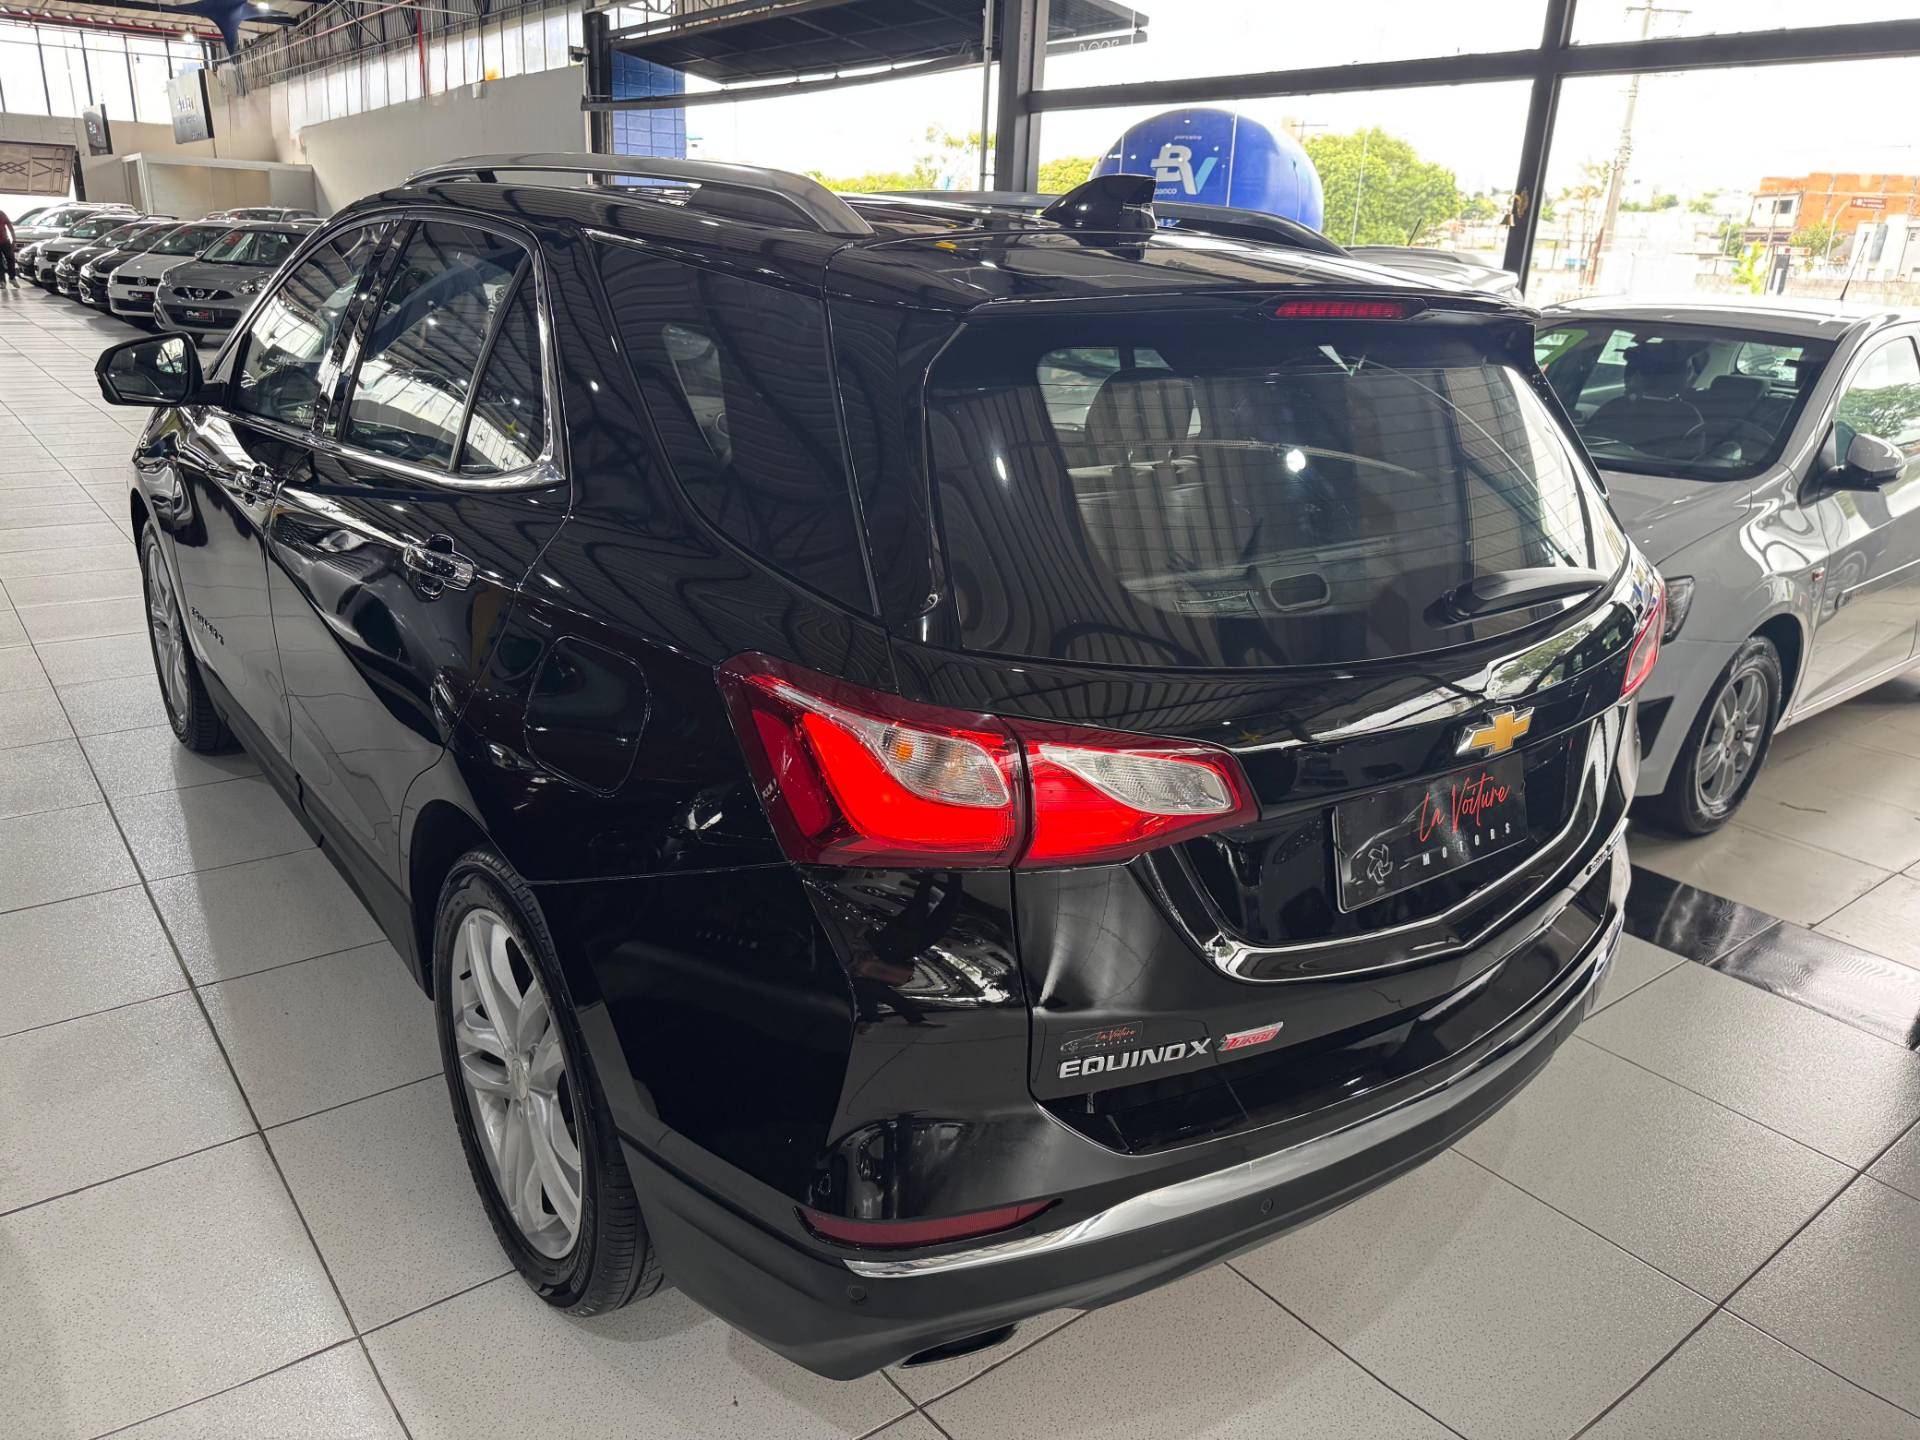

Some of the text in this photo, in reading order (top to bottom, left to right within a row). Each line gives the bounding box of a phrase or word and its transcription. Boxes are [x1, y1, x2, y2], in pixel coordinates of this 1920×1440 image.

[1150, 144, 1219, 196] BV
[1418, 772, 1512, 843] La Voiture
[1422, 822, 1511, 866] MOTORS
[1058, 1037, 1212, 1079] EQUINOX
